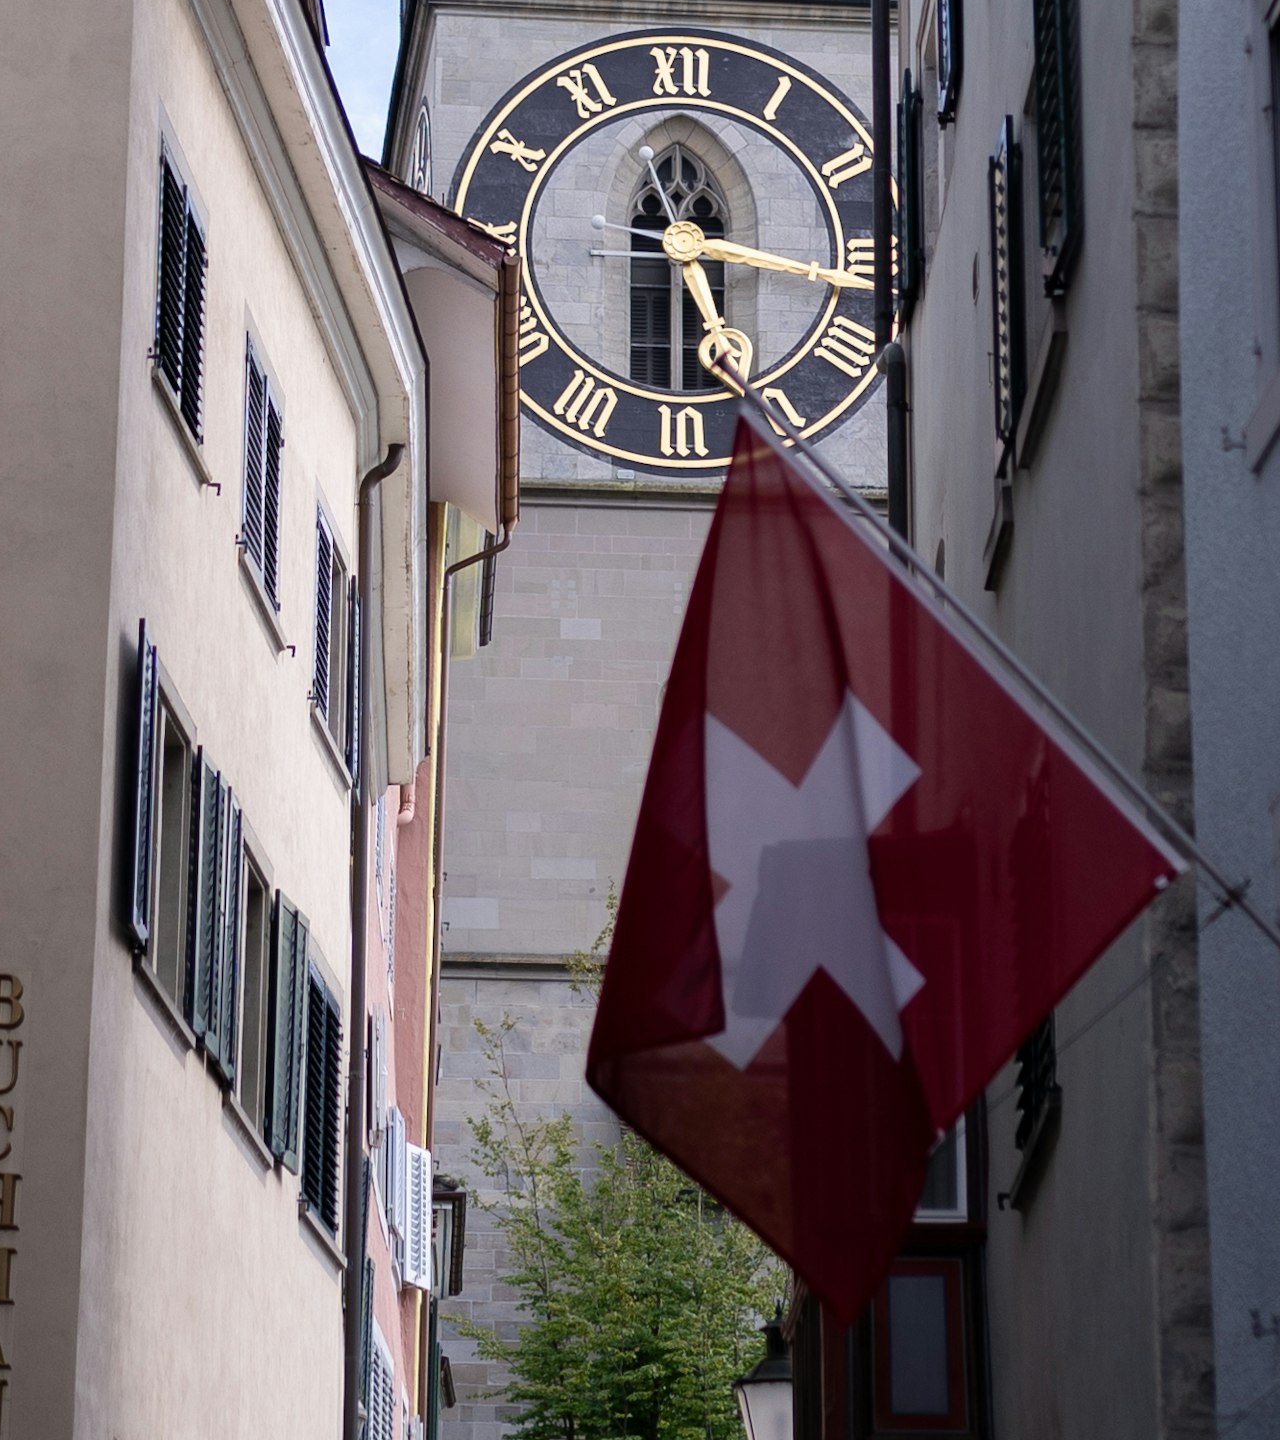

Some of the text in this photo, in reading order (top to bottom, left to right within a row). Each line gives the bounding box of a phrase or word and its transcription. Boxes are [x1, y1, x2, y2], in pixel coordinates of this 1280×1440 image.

[557, 63, 616, 119] XI
[650, 46, 711, 97] XII
[490, 128, 546, 172] X
